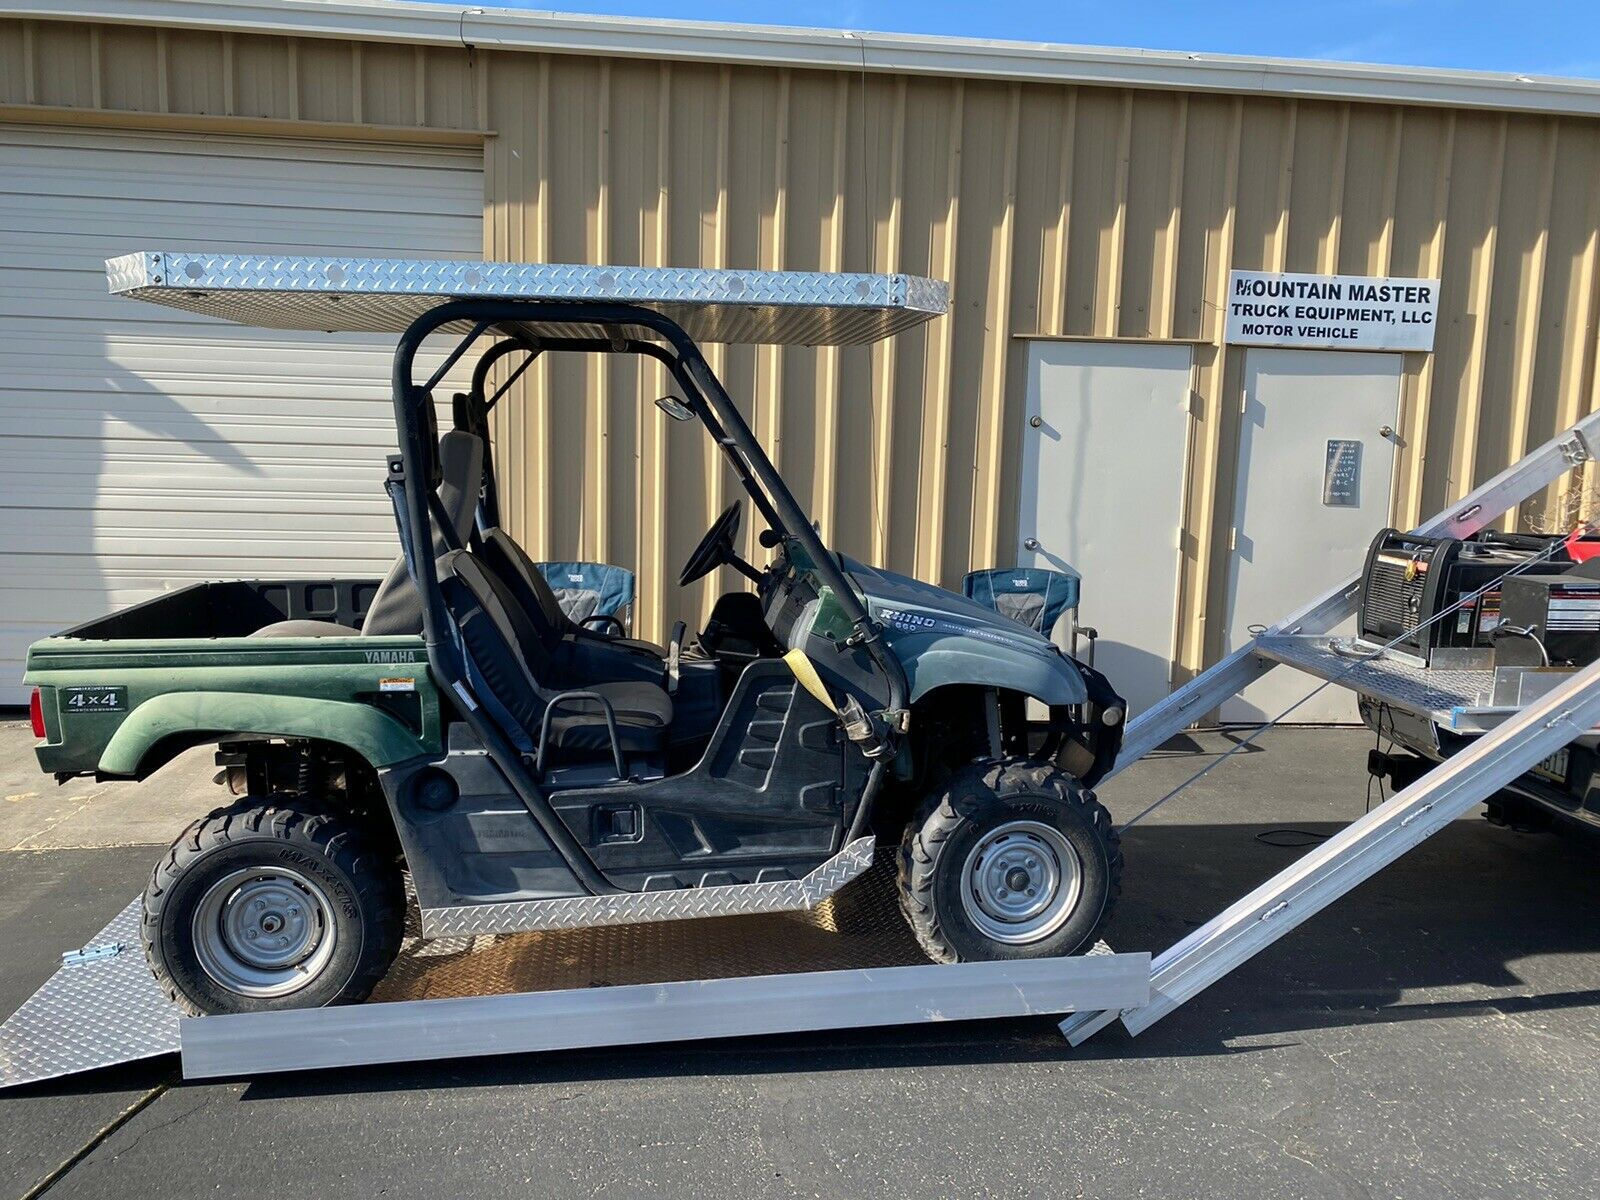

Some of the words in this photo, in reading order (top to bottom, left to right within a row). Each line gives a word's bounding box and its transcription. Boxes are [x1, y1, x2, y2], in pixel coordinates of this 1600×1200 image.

[1236, 279, 1342, 300] MOUNTAIN
[1349, 284, 1431, 304] MASTER
[1231, 303, 1290, 318] TRUCK
[1295, 306, 1396, 326] EQUIPMENT,
[1401, 310, 1433, 324] LLC
[1242, 323, 1293, 337] MOTOR
[1298, 326, 1359, 339] VEHICLE
[880, 609, 936, 628] RHINO
[365, 651, 416, 664] YAMAHA
[278, 849, 358, 919] MAXXIS
